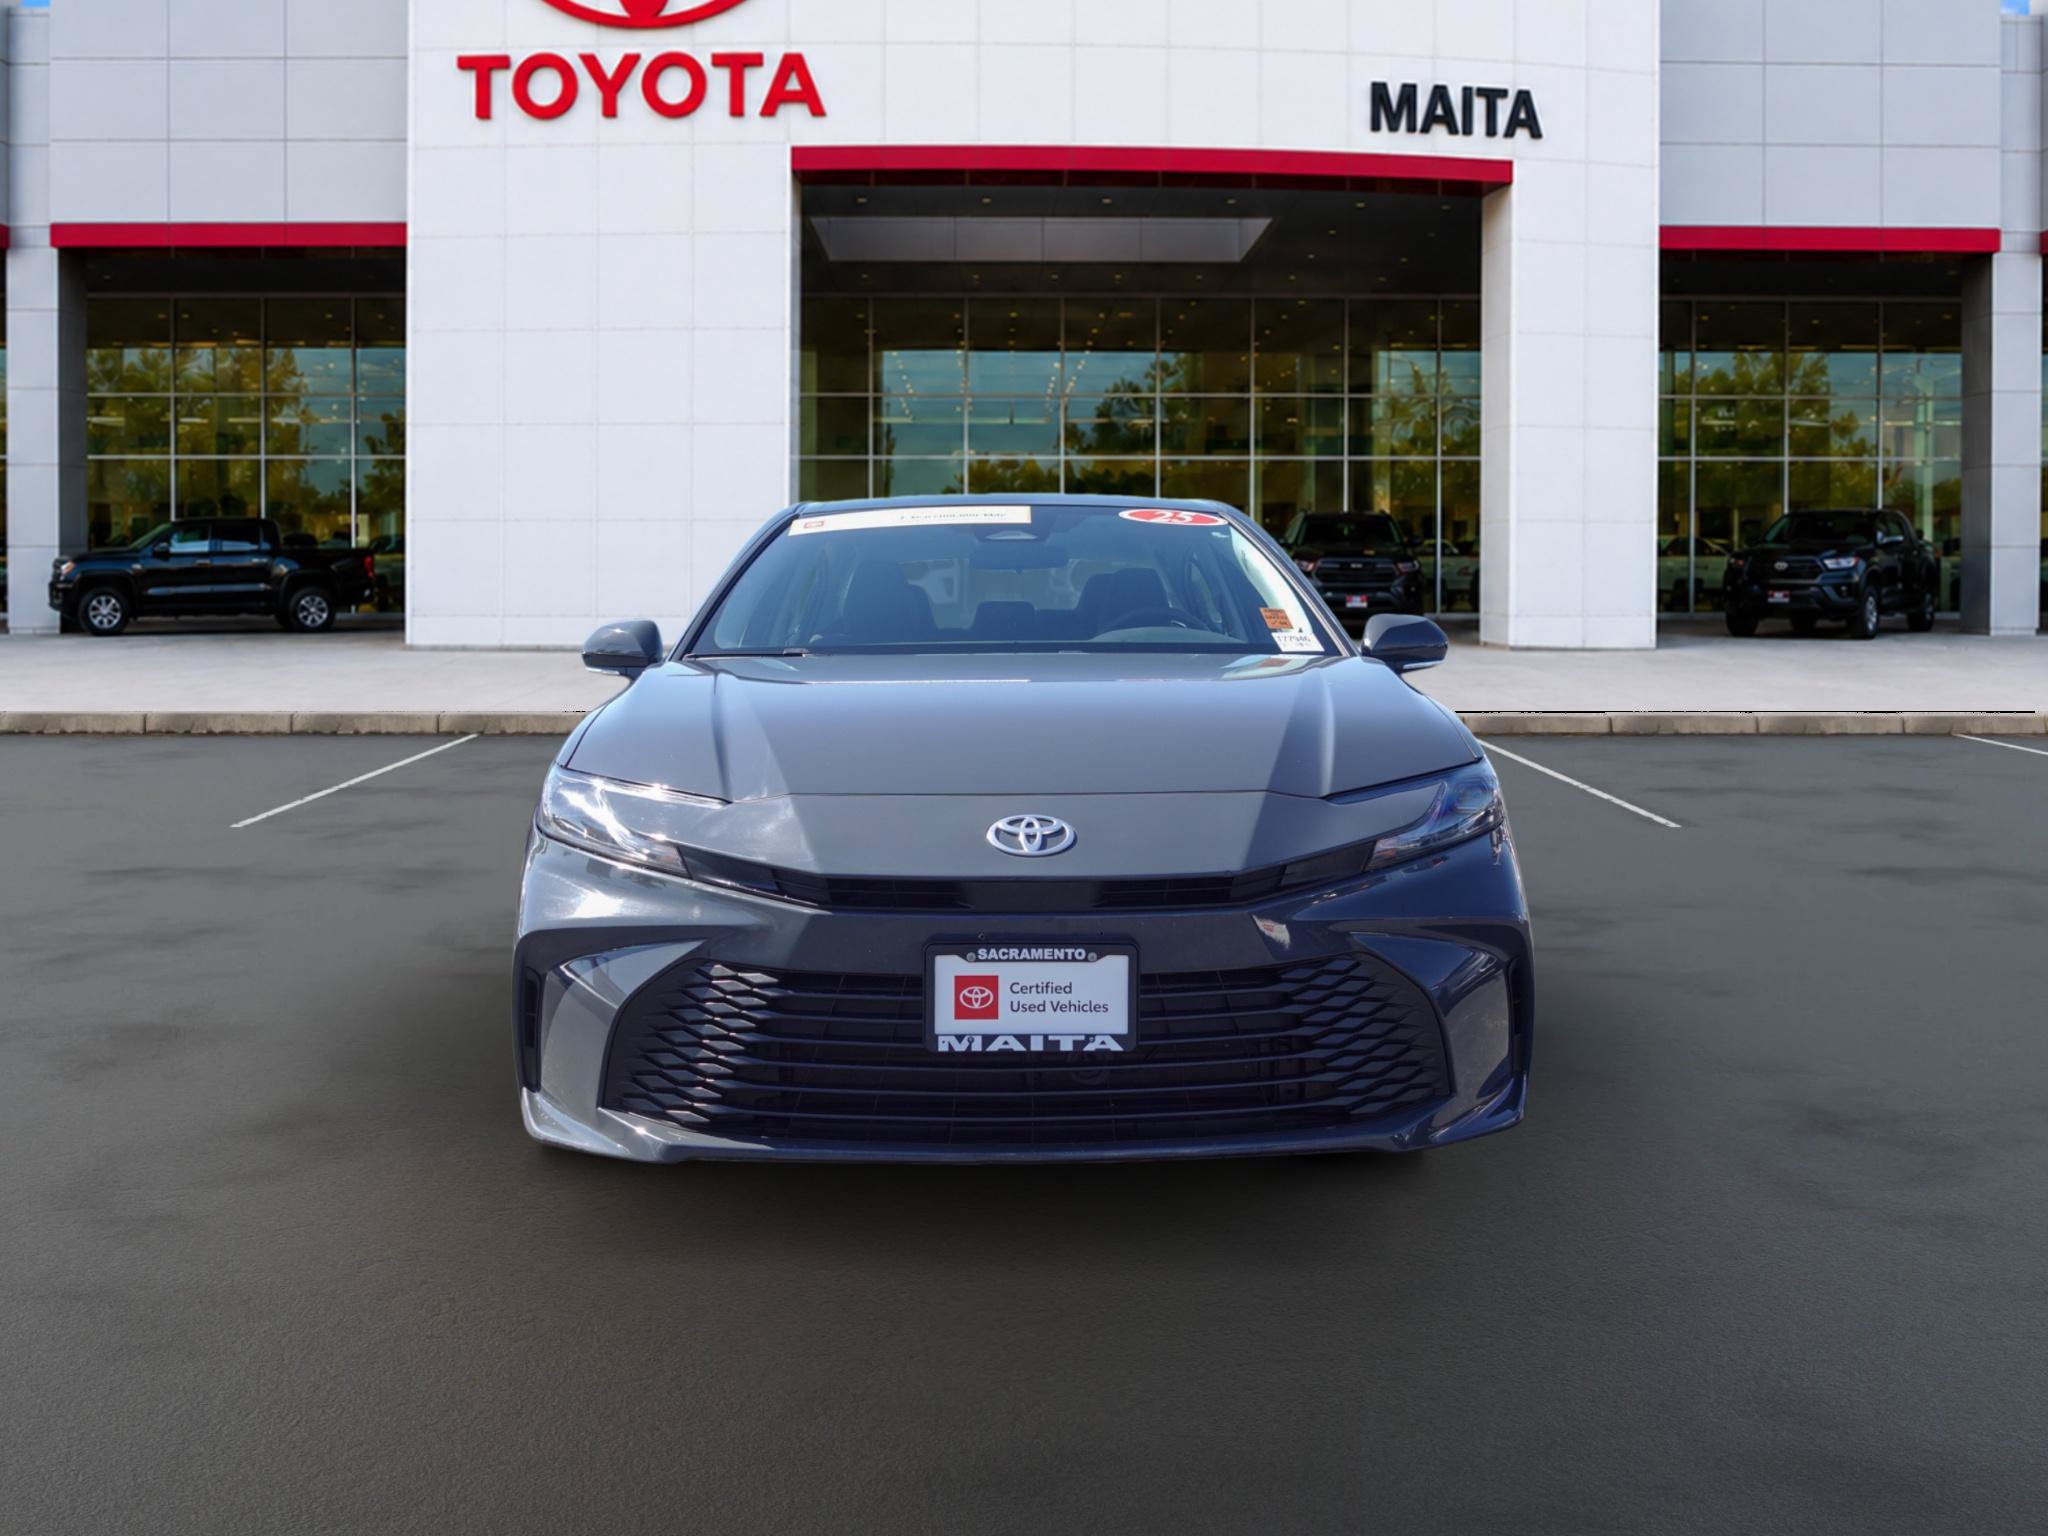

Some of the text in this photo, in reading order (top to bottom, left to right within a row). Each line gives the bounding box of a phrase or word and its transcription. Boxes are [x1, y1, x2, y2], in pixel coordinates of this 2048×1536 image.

[456, 51, 827, 120] TOYOTA
[1370, 81, 1543, 139] MAITA
[1150, 510, 1194, 523] 25
[977, 948, 1087, 960] SACRAMENTO
[1009, 981, 1073, 995] Certified
[1009, 1000, 1109, 1013] Used Vehicles
[937, 1034, 1124, 1052] MAITA
